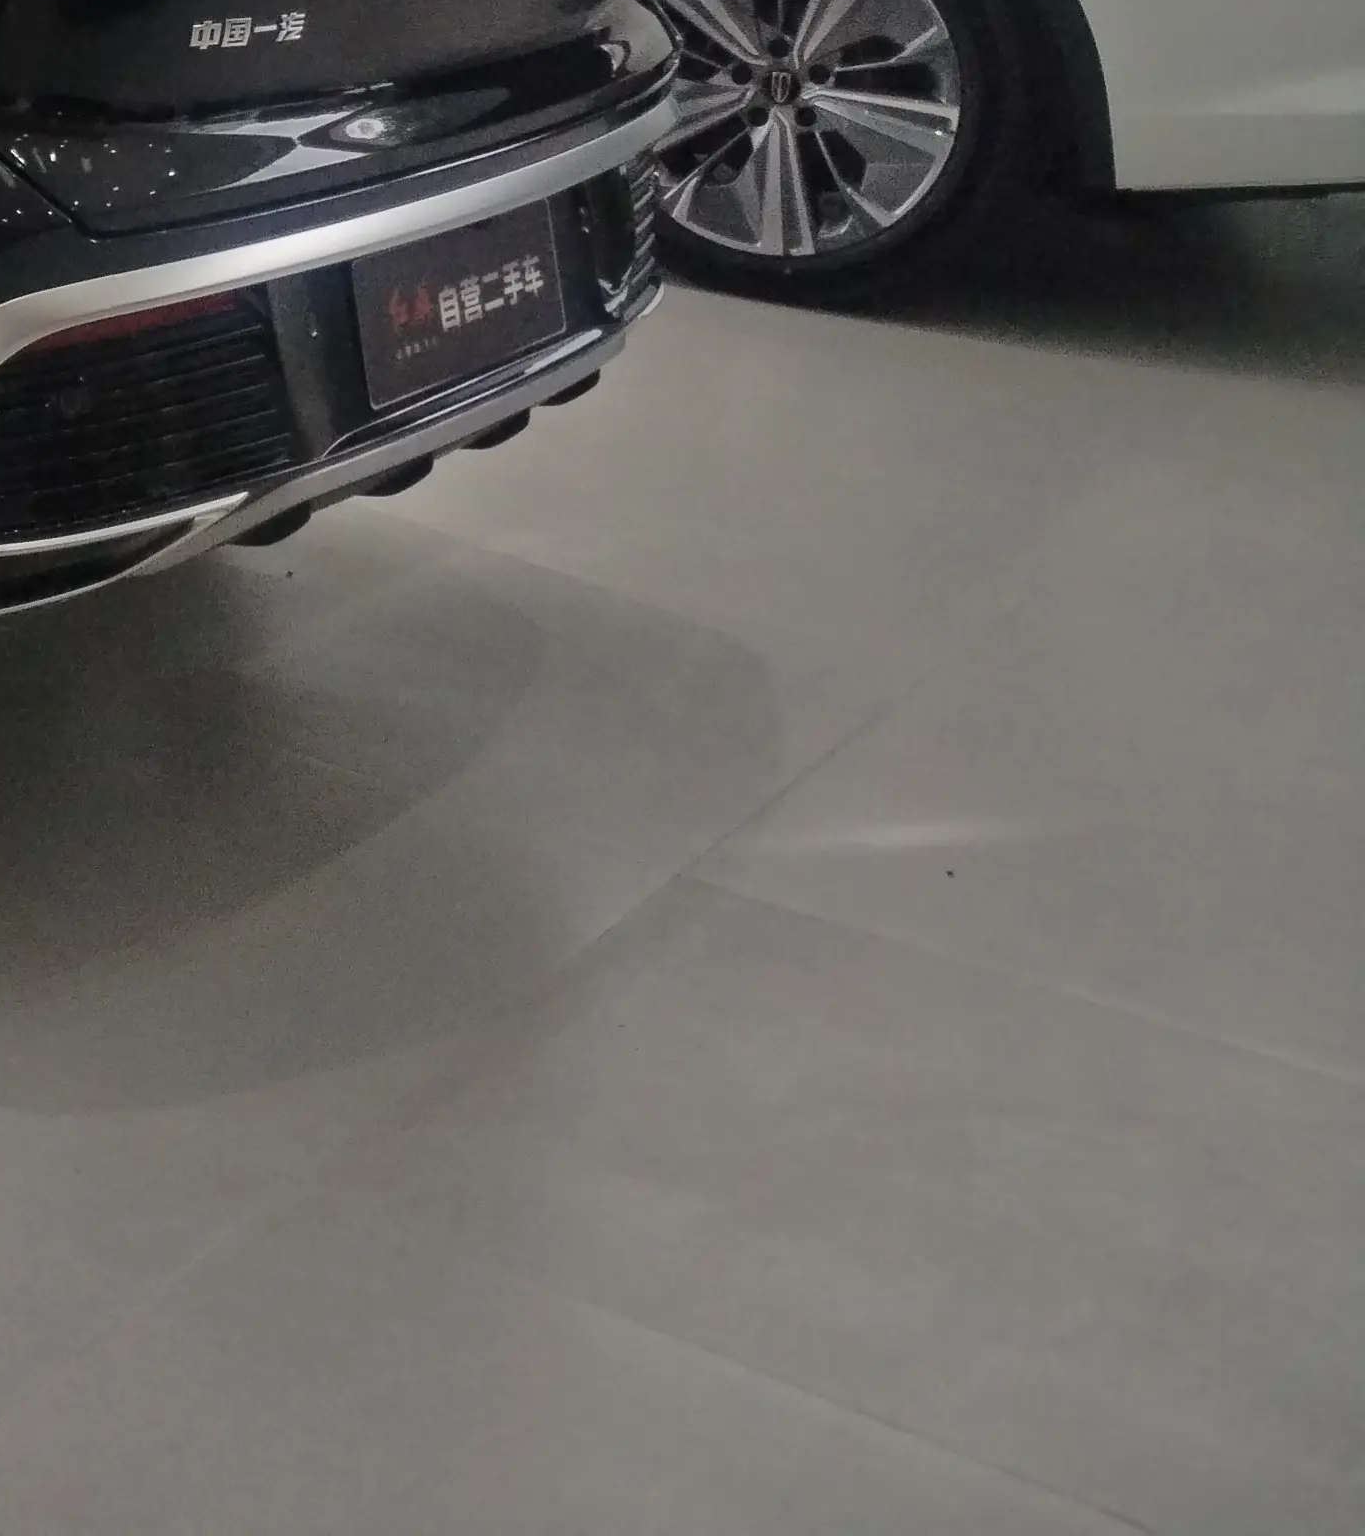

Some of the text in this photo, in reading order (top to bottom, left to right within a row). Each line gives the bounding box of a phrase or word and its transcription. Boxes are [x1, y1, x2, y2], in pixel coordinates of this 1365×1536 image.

[189, 12, 306, 50] 中国一汽
[439, 255, 544, 332] 自营二手车
